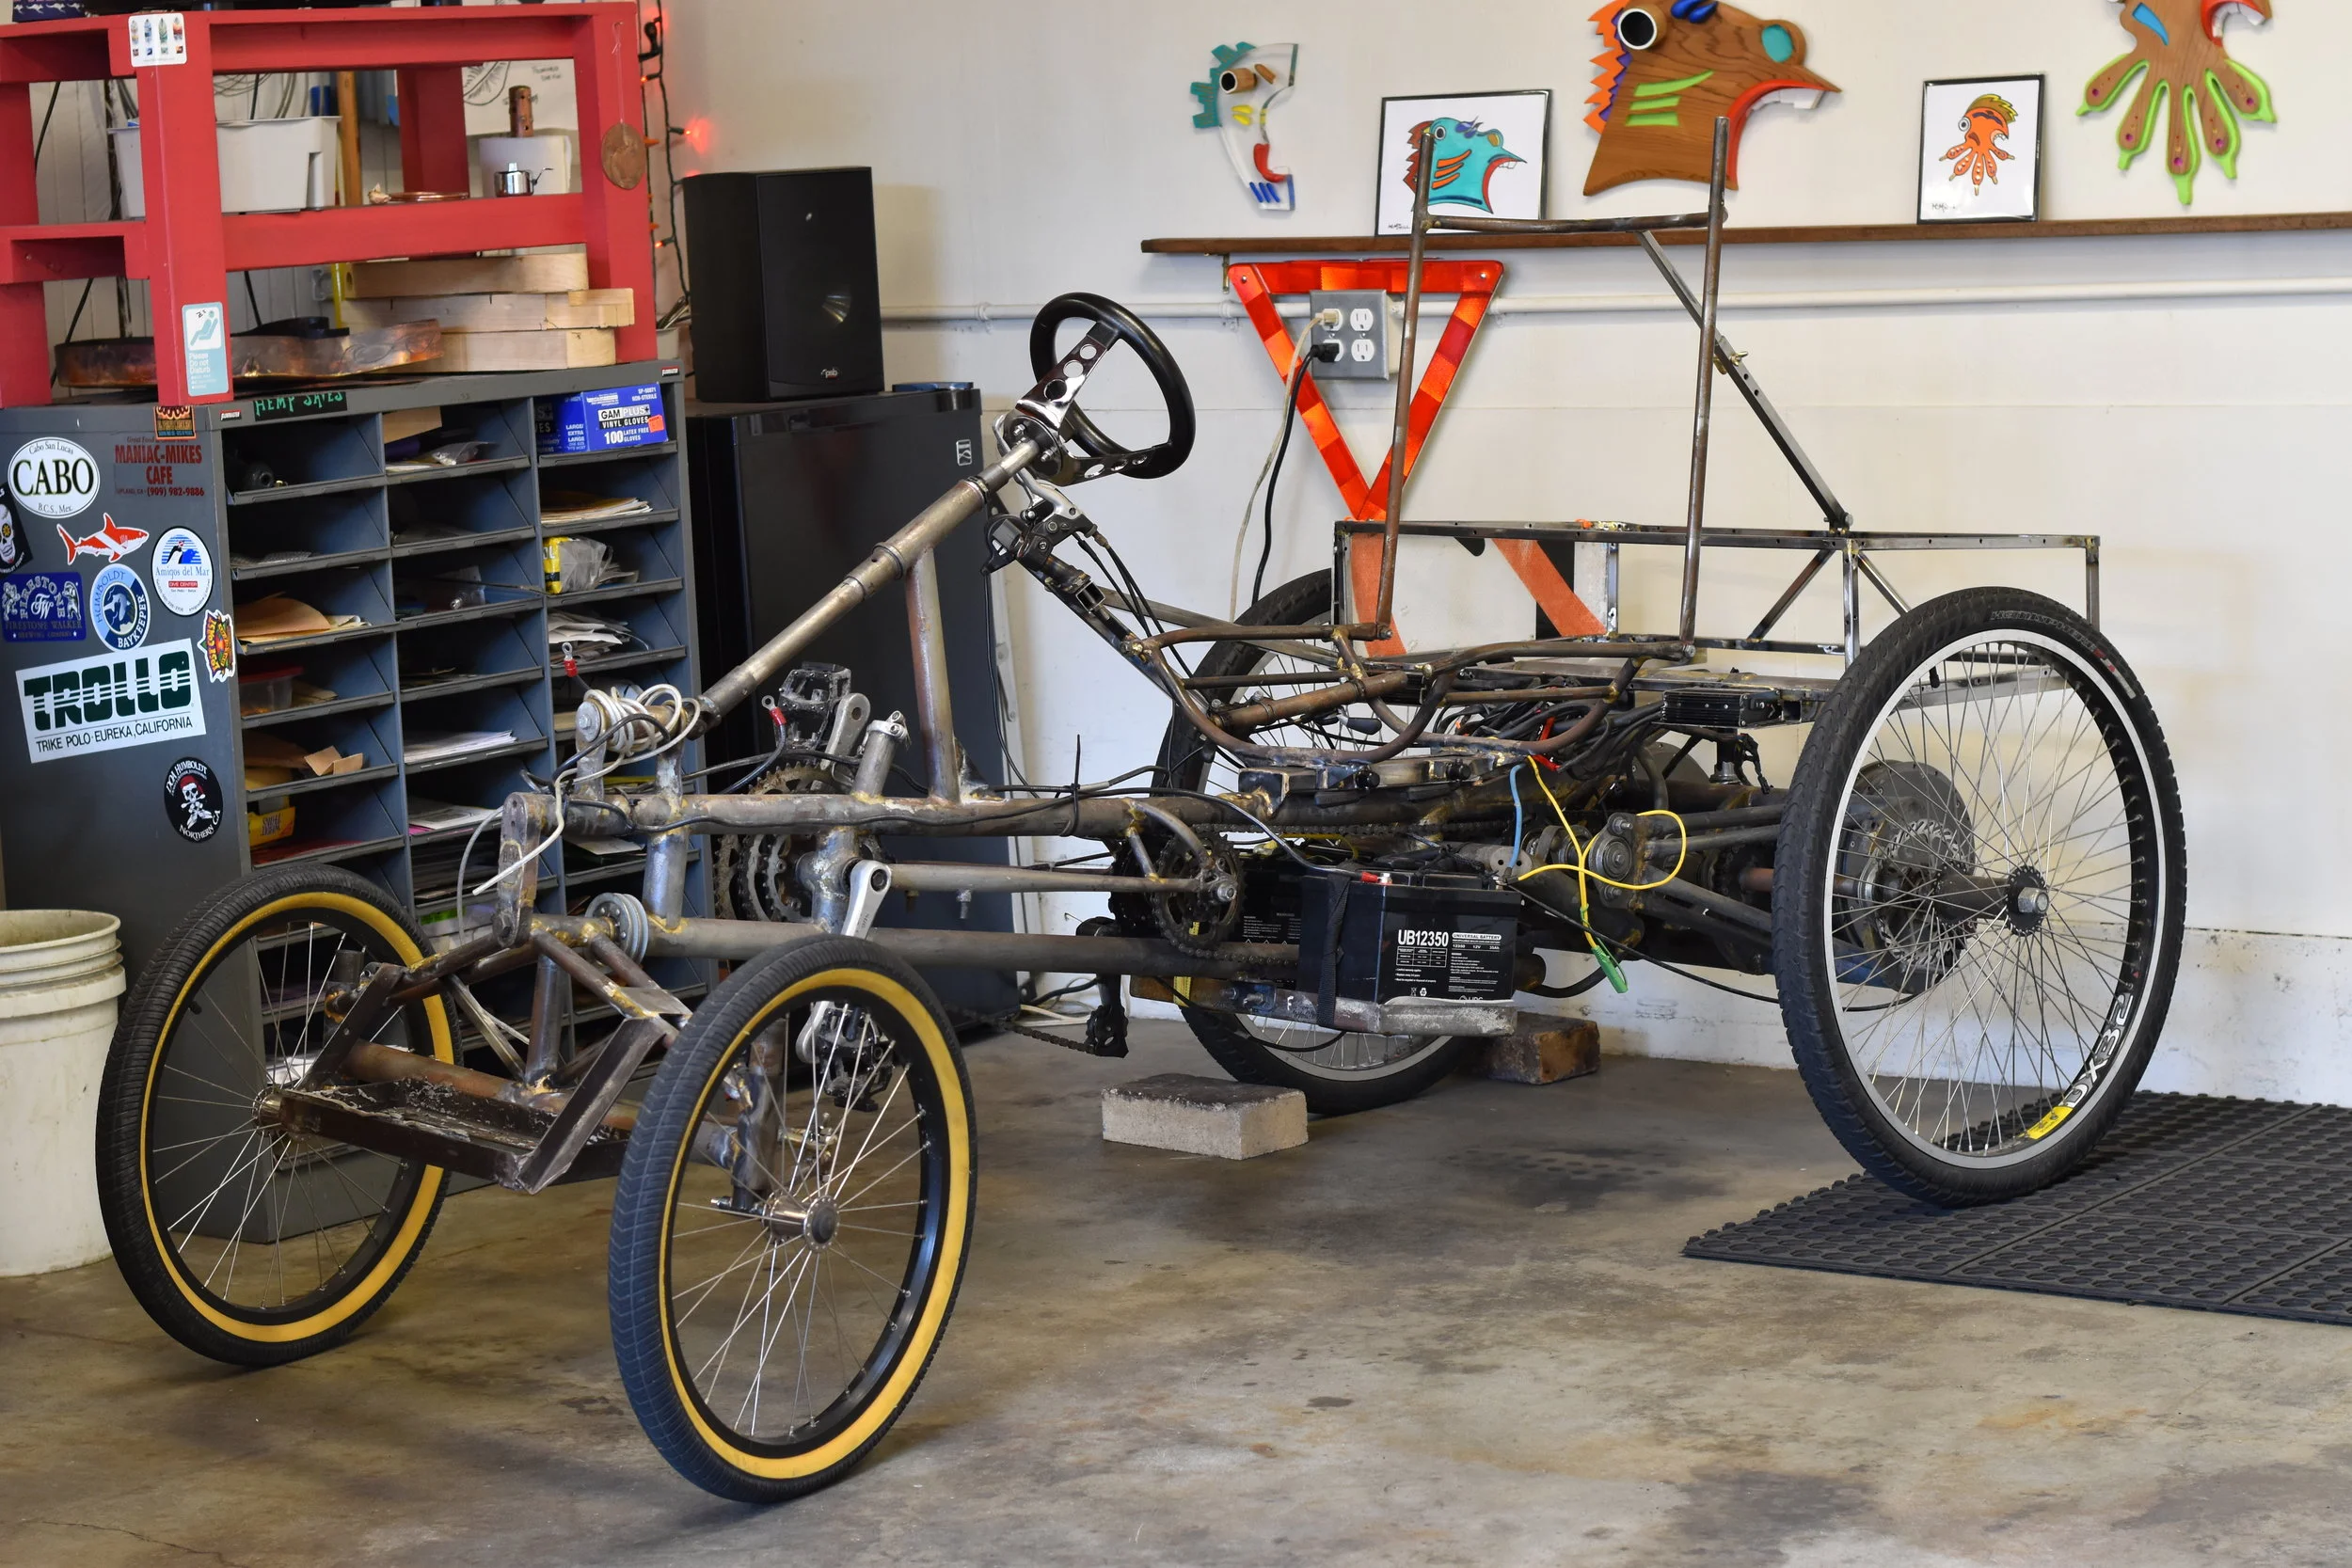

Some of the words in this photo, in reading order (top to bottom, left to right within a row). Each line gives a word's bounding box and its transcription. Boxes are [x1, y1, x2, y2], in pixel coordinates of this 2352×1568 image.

[255, 396, 295, 417] HEMP
[600, 409, 620, 420] GAM
[602, 420, 622, 429] VINYL
[624, 416, 649, 426] GLOVES
[604, 431, 623, 444] 100
[29, 443, 44, 455] Cabo
[45, 441, 56, 450] San
[57, 442, 74, 455] Lucas
[115, 444, 202, 464] MANIAC-MIKES
[13, 458, 94, 496] CABO
[146, 466, 173, 484] CAFE
[147, 488, 167, 497] (909)
[169, 488, 204, 496] 982-9886
[59, 504, 73, 513] Mex.
[156, 566, 180, 579] Amigos
[182, 566, 192, 576] del
[195, 567, 210, 576] Mar
[20, 576, 65, 619] FIRESTONE
[95, 570, 126, 623] HUMBOLDT
[6, 621, 48, 630] FIRESTONE
[51, 620, 82, 629] WALKER
[117, 594, 146, 648] BAYKEEPER
[207, 617, 217, 646] COAST
[208, 647, 221, 672] LOST
[24, 650, 191, 731] TROLLO
[36, 737, 63, 752] TRIKE
[66, 732, 91, 747] POLO
[135, 716, 193, 736] CALIFORNIA
[175, 760, 207, 775] HUMBOLDT
[179, 824, 214, 841] NORTHERN
[212, 810, 220, 825] CA
[1398, 929, 1449, 947] UB12350
[2058, 993, 2134, 1108] DX32
